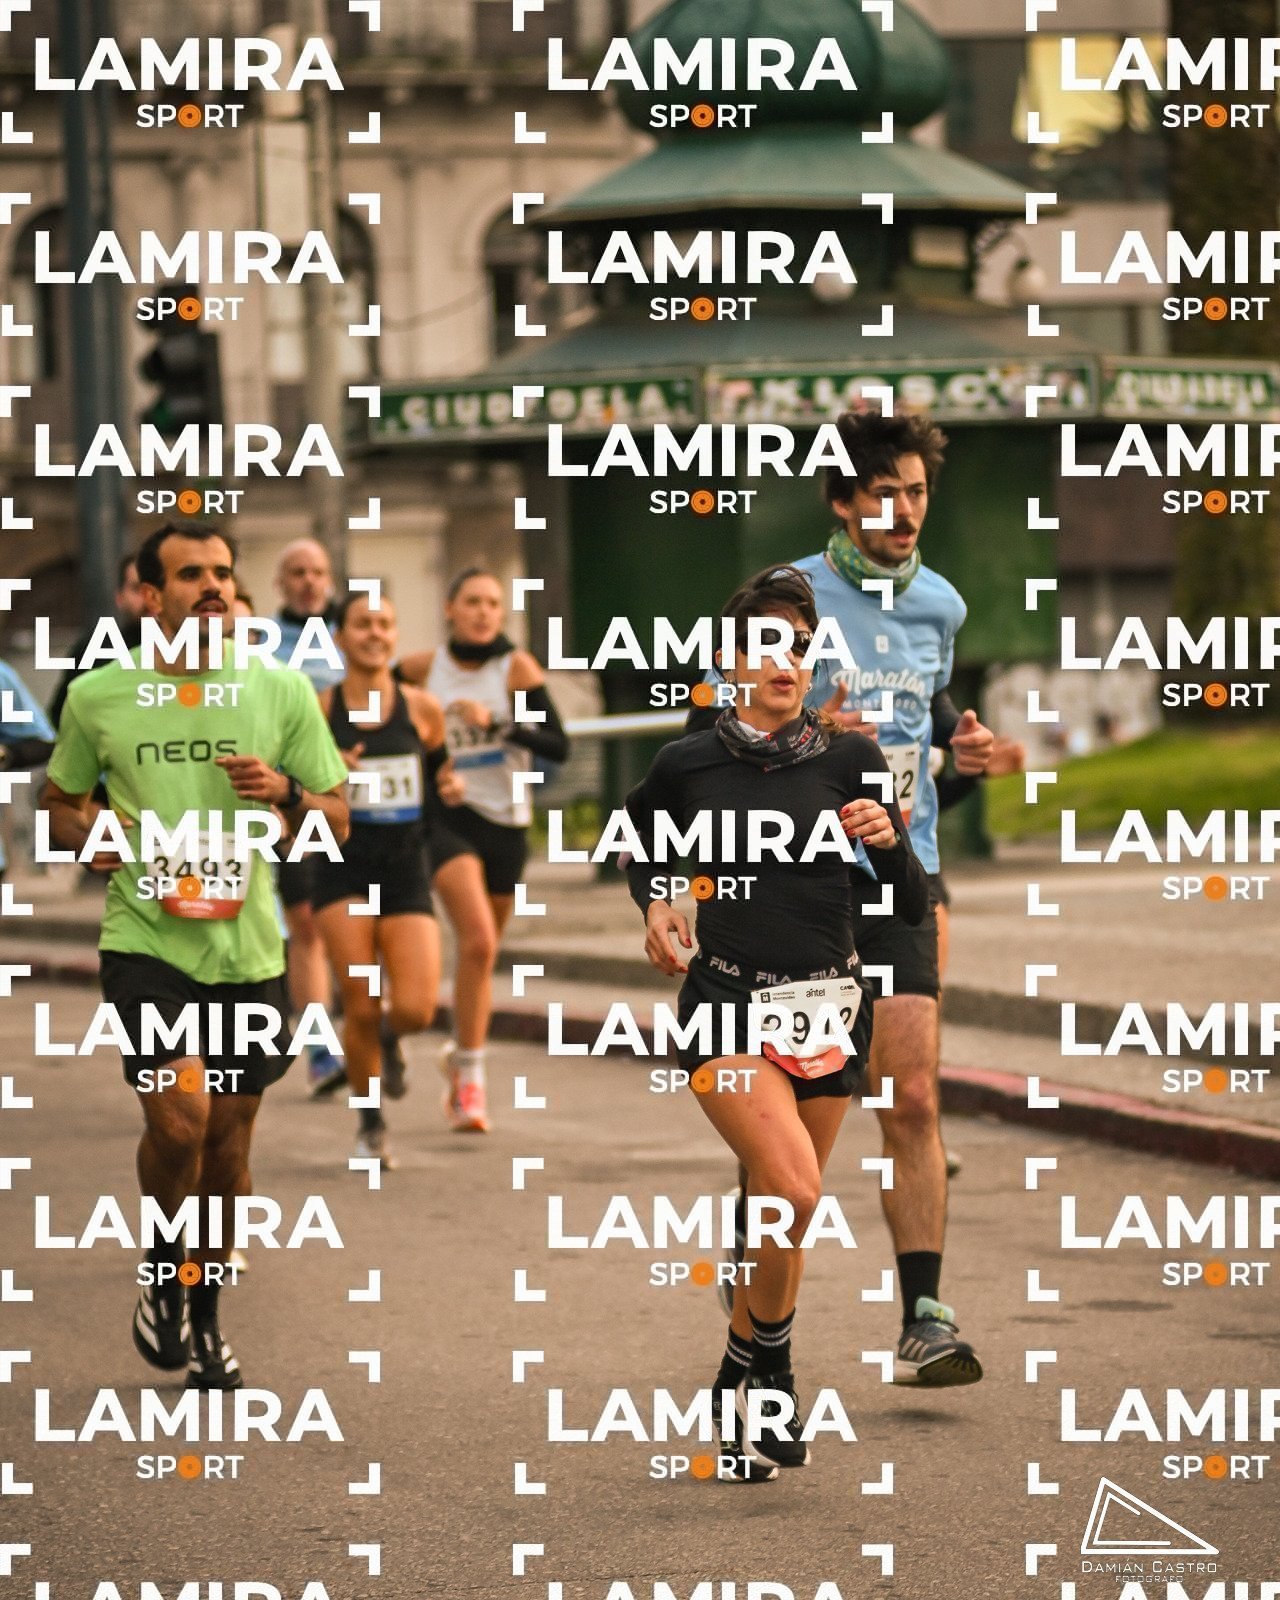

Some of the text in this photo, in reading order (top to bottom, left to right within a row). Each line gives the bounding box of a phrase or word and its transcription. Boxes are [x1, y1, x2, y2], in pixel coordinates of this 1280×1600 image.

[153, 856, 242, 888] 3493
[709, 956, 741, 977] FILA
[809, 966, 839, 982] FILA
[755, 971, 793, 987] FILA
